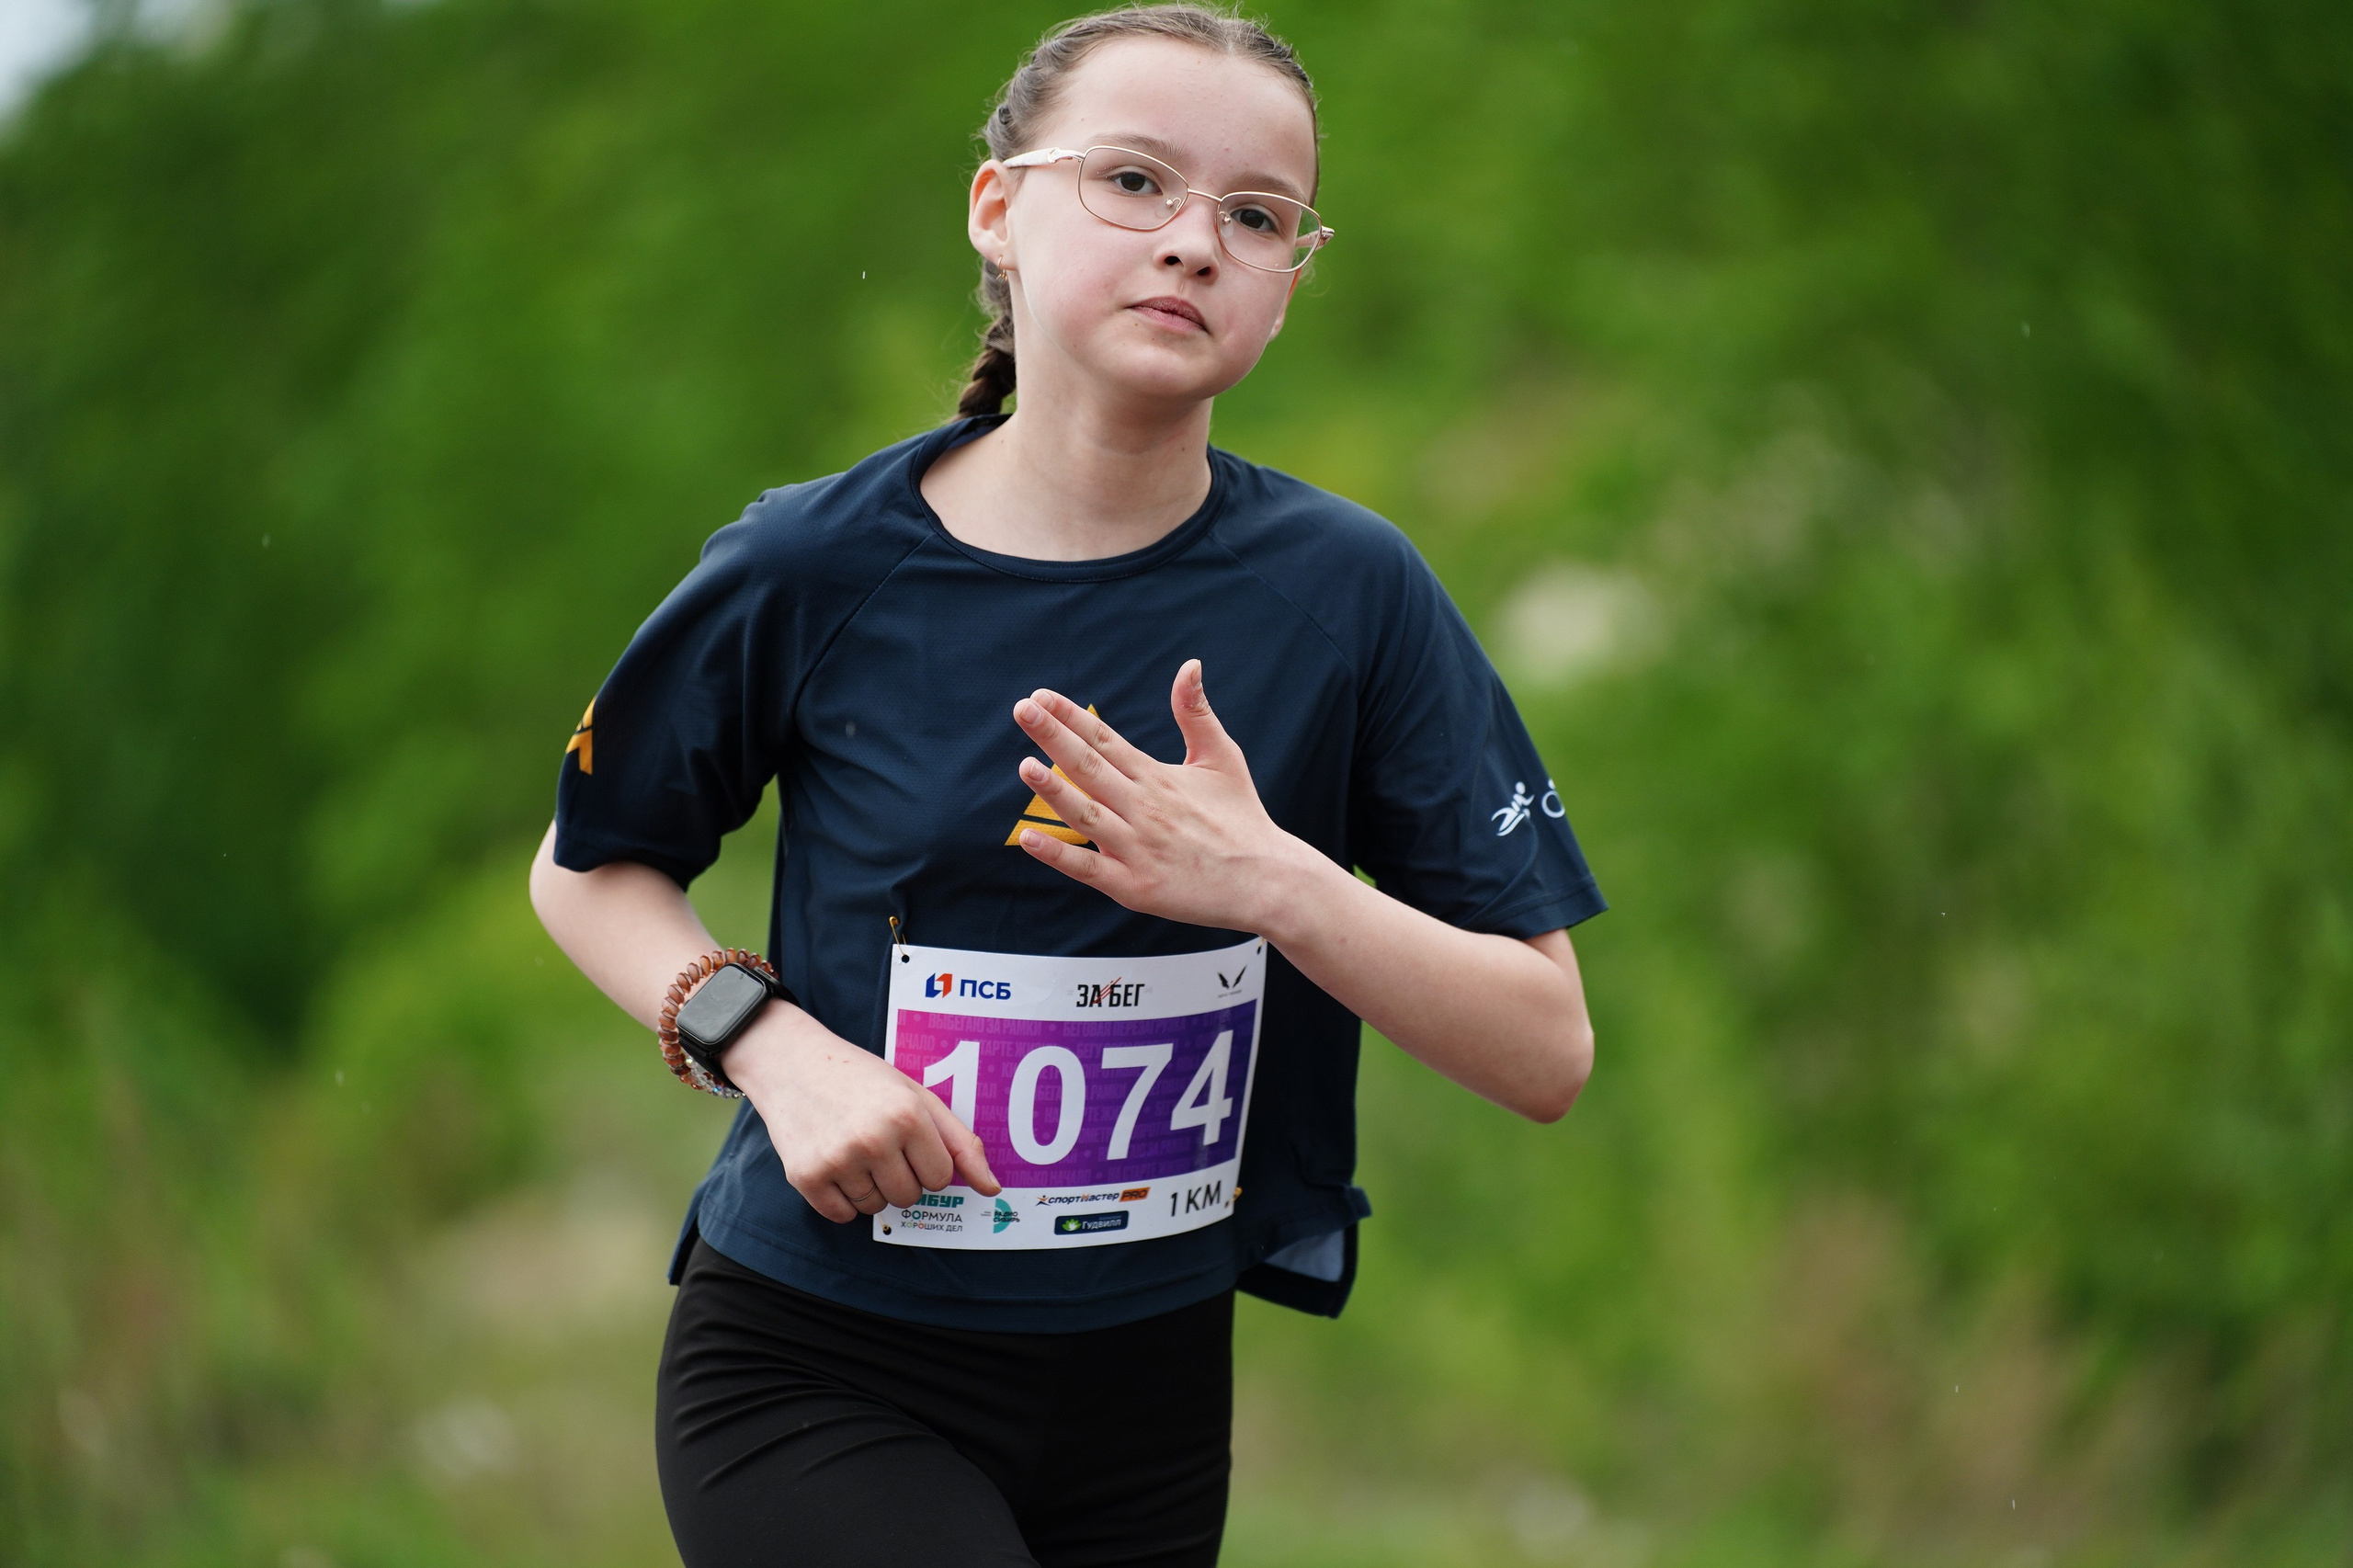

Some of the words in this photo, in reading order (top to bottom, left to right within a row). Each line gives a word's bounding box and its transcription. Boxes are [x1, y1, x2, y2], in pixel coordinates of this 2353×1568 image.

[960, 979, 1012, 1000] ПСБ
[897, 1031, 936, 1051] АЧАЛО
[923, 1029, 1233, 1165] 1074
[915, 1194, 964, 1209] ИБУР
[1121, 1189, 1148, 1200] PRO
[1170, 1192, 1179, 1217] 1
[901, 1209, 963, 1223] ФОРМУЛА
[901, 1221, 944, 1231] ХОРОШИХ
[945, 1224, 963, 1233] ДЕЛ
